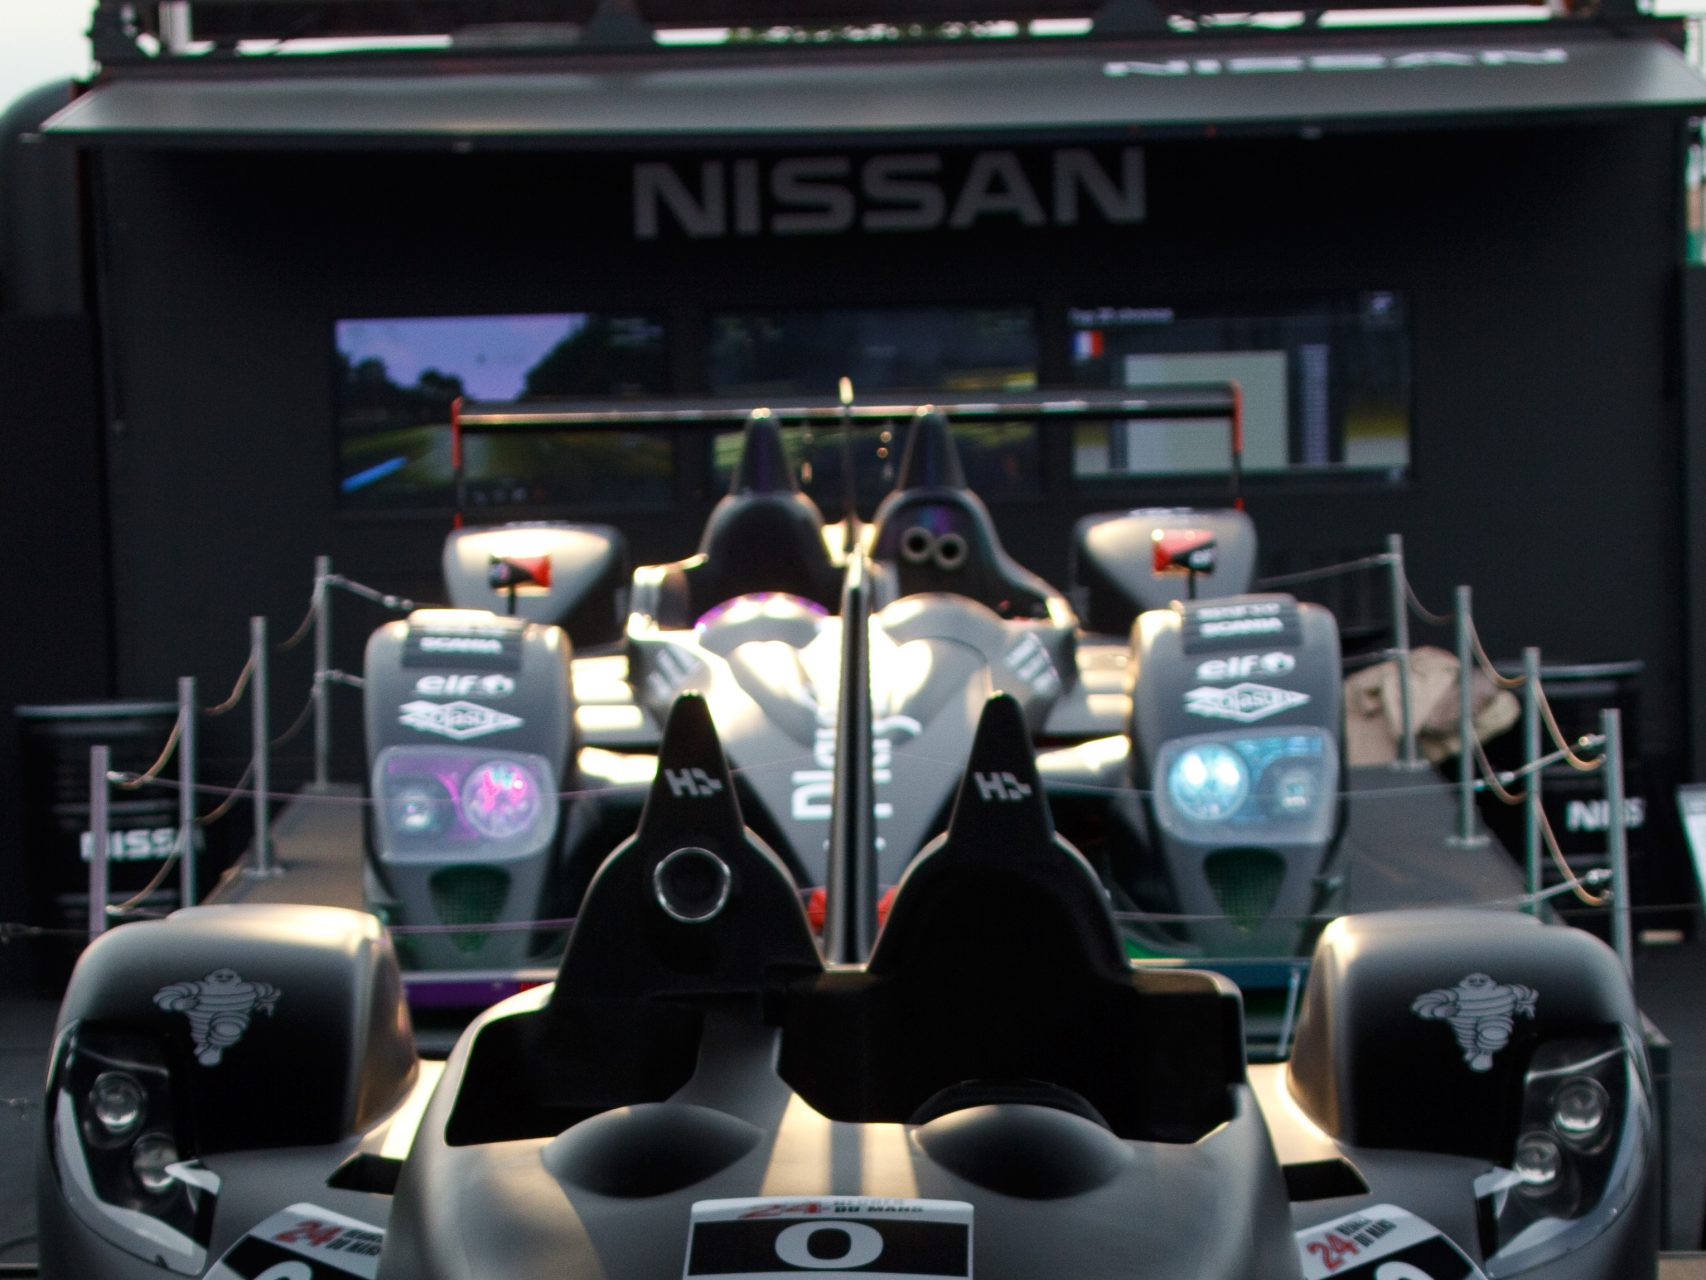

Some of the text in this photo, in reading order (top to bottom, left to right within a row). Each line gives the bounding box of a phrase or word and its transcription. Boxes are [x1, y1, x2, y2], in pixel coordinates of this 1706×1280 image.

[633, 147, 1148, 240] NISSAN
[775, 1220, 883, 1269] 0
[1306, 1233, 1361, 1271] 24
